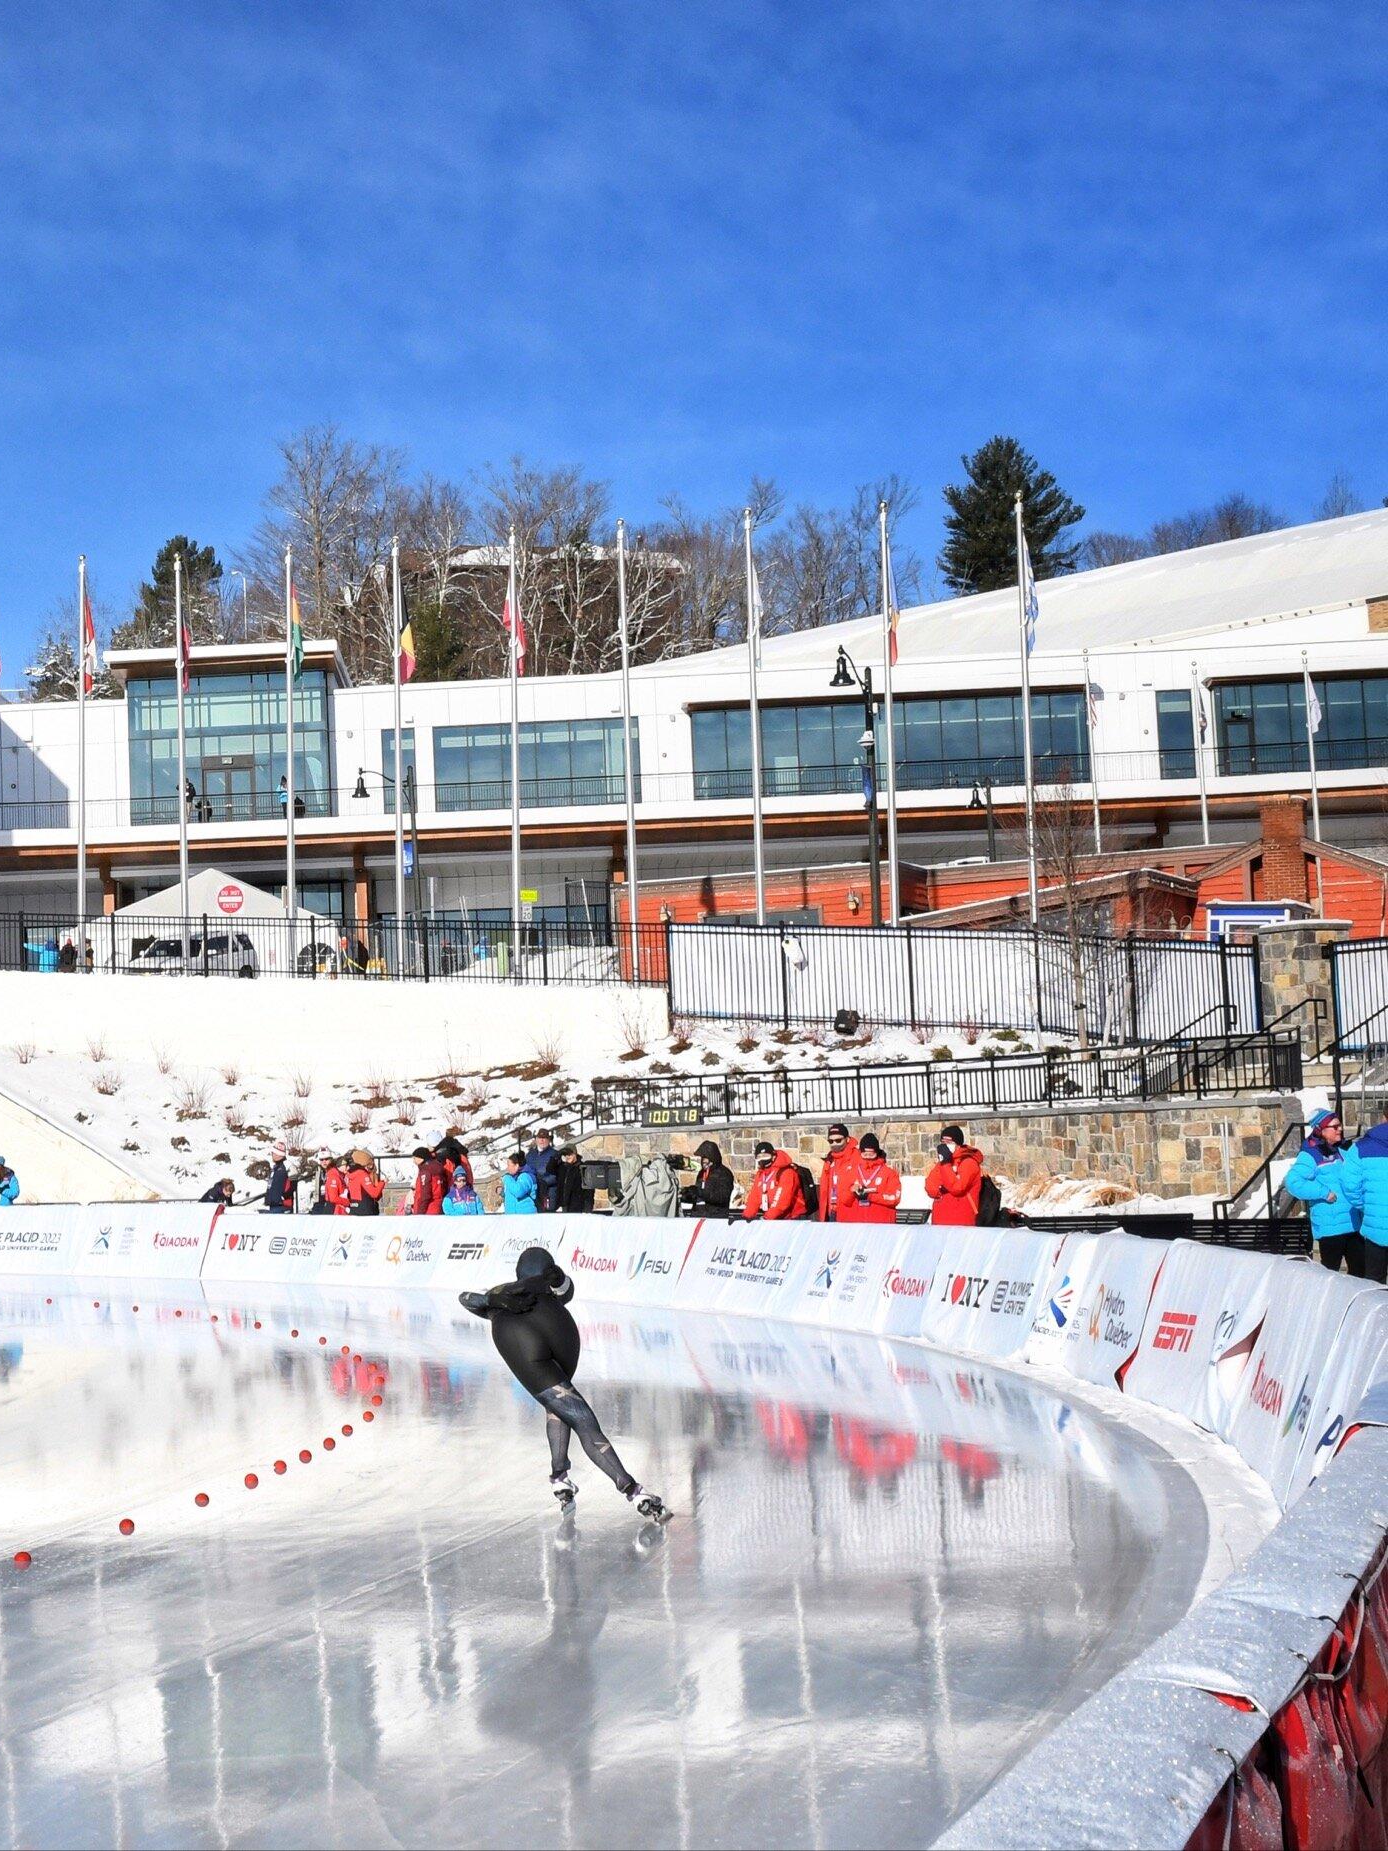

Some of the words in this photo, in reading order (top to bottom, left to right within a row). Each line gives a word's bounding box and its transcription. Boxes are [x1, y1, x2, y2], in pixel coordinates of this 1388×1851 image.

[4, 1232, 40, 1244] PLACID
[40, 1232, 62, 1244] 2023
[160, 1236, 200, 1248] QIAODAN
[221, 1233, 229, 1251] I
[237, 1235, 261, 1252] NY
[403, 1238, 423, 1249] Hydro
[288, 1248, 312, 1257] CENTER
[710, 1247, 737, 1265] LAKE
[578, 1254, 618, 1272] QIAODAN
[642, 1259, 672, 1275] FISU
[734, 1272, 766, 1284] UNIVERSITY
[941, 1273, 954, 1302] I
[958, 1276, 990, 1309] NY
[1003, 1300, 1027, 1316] CENTER
[1102, 1288, 1125, 1317] Hydro
[1152, 1311, 1198, 1353] ESPN
